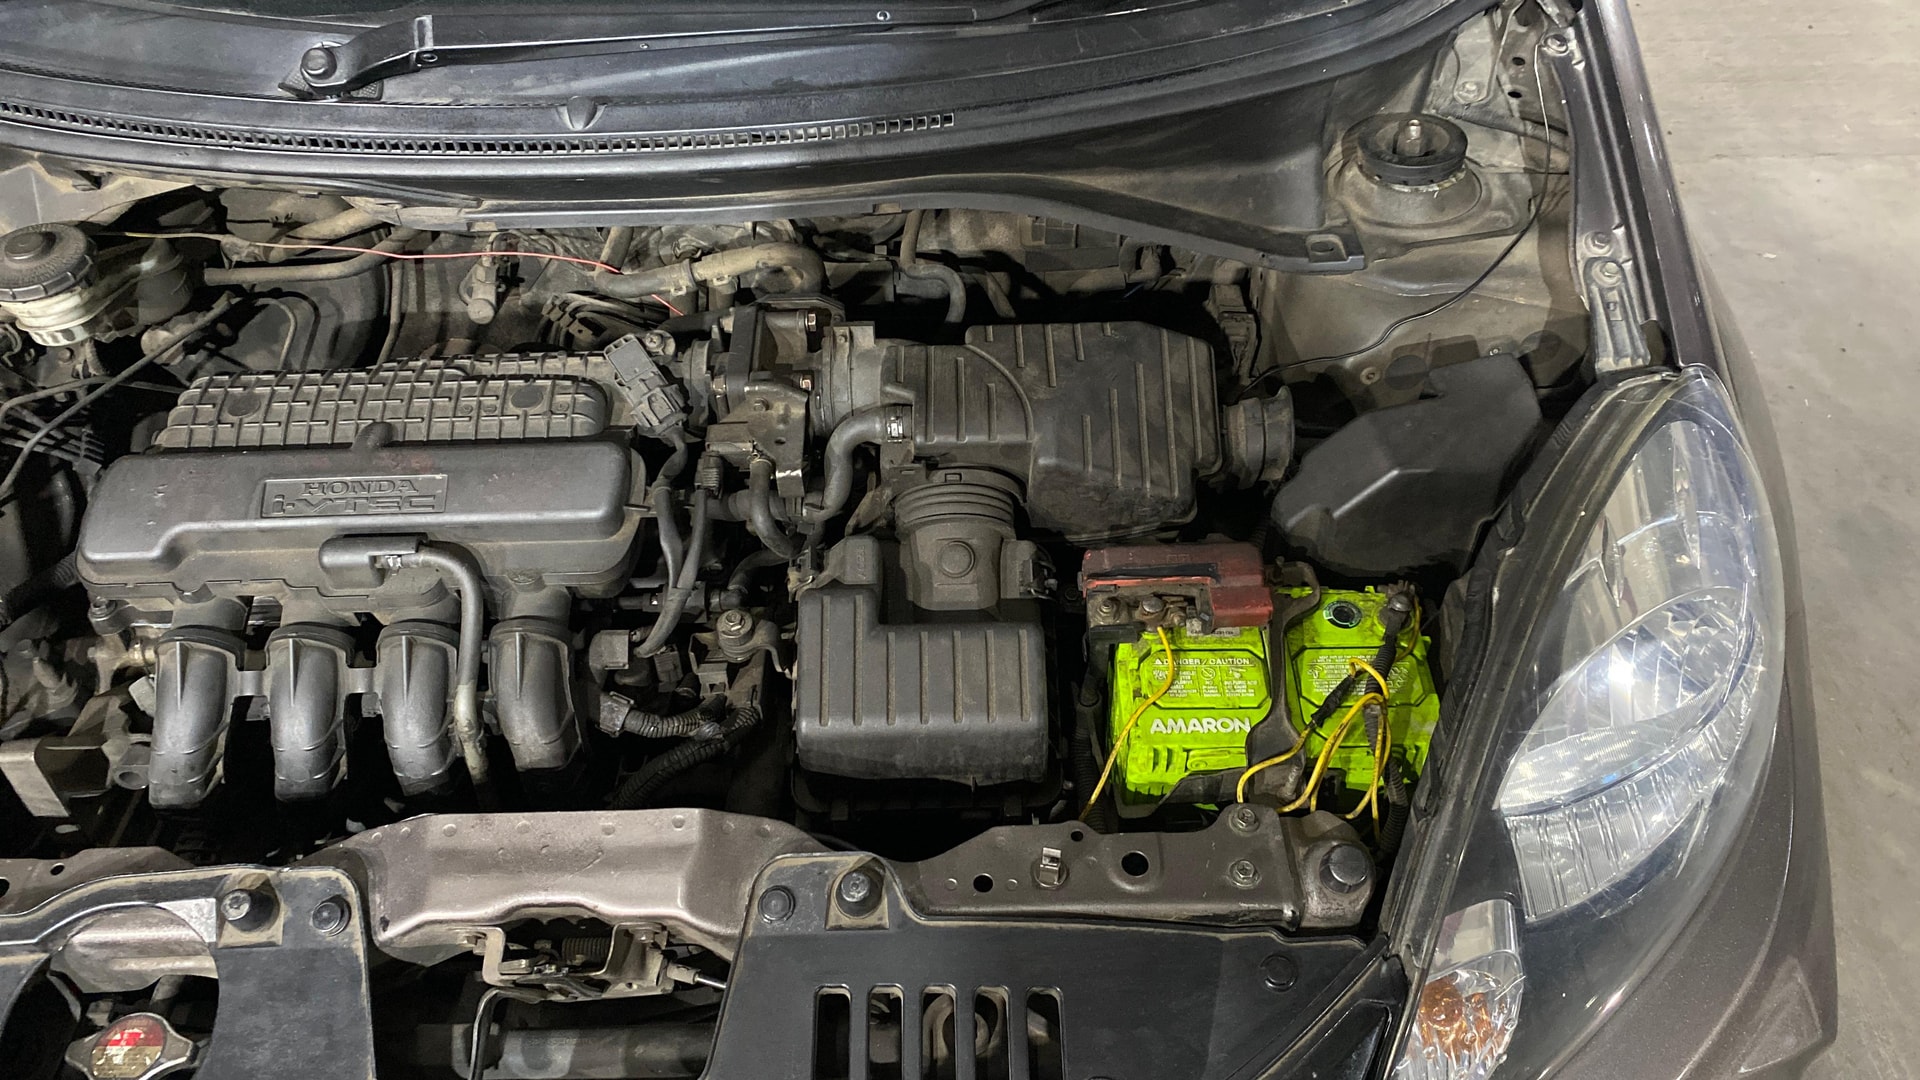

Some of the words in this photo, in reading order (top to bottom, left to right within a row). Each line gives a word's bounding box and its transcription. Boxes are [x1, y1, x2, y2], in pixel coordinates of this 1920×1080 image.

[301, 479, 419, 496] HONDA
[271, 494, 436, 515] i-VTEC
[1150, 717, 1251, 735] AMARON
